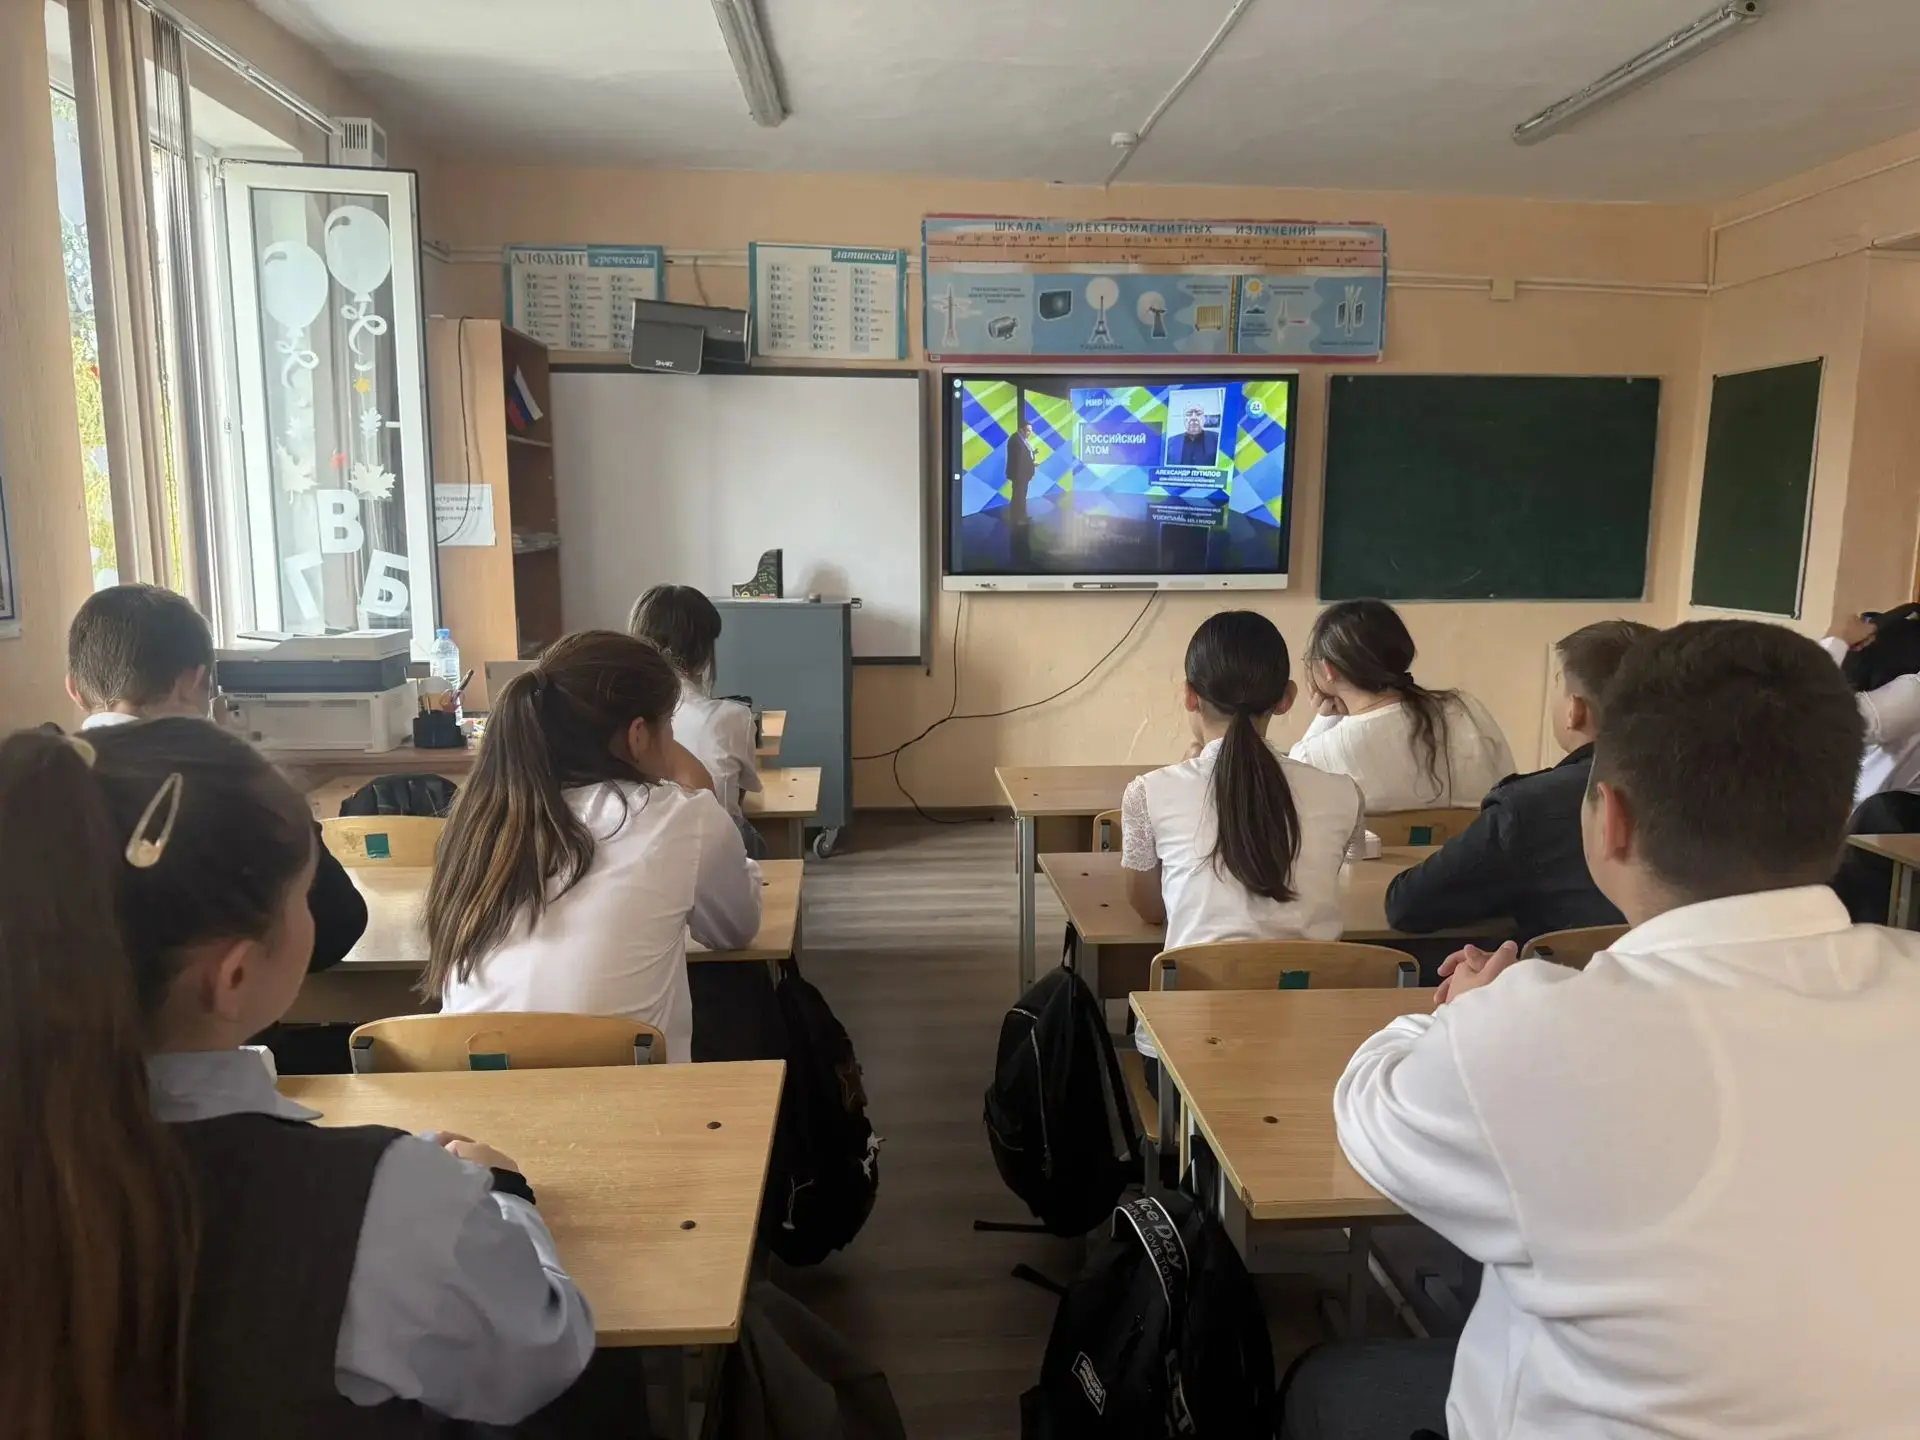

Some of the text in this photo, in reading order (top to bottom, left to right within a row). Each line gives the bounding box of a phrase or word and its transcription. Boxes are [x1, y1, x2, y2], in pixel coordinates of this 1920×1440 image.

[994, 221, 1317, 236] ШКАЛА ЭЛЕКТРОМАГНИТНЫХ ИЗЛУЧЕНИЙ
[512, 252, 585, 266] АЛФАВИТ
[833, 250, 896, 262] латинский
[1084, 432, 1146, 445] РОССИЙСКИЙ
[1084, 446, 1109, 455] АТОМ
[316, 489, 364, 553] В
[360, 549, 409, 618] Б
[1142, 1226, 1162, 1257] LOVE
[1153, 1224, 1183, 1271] Day
